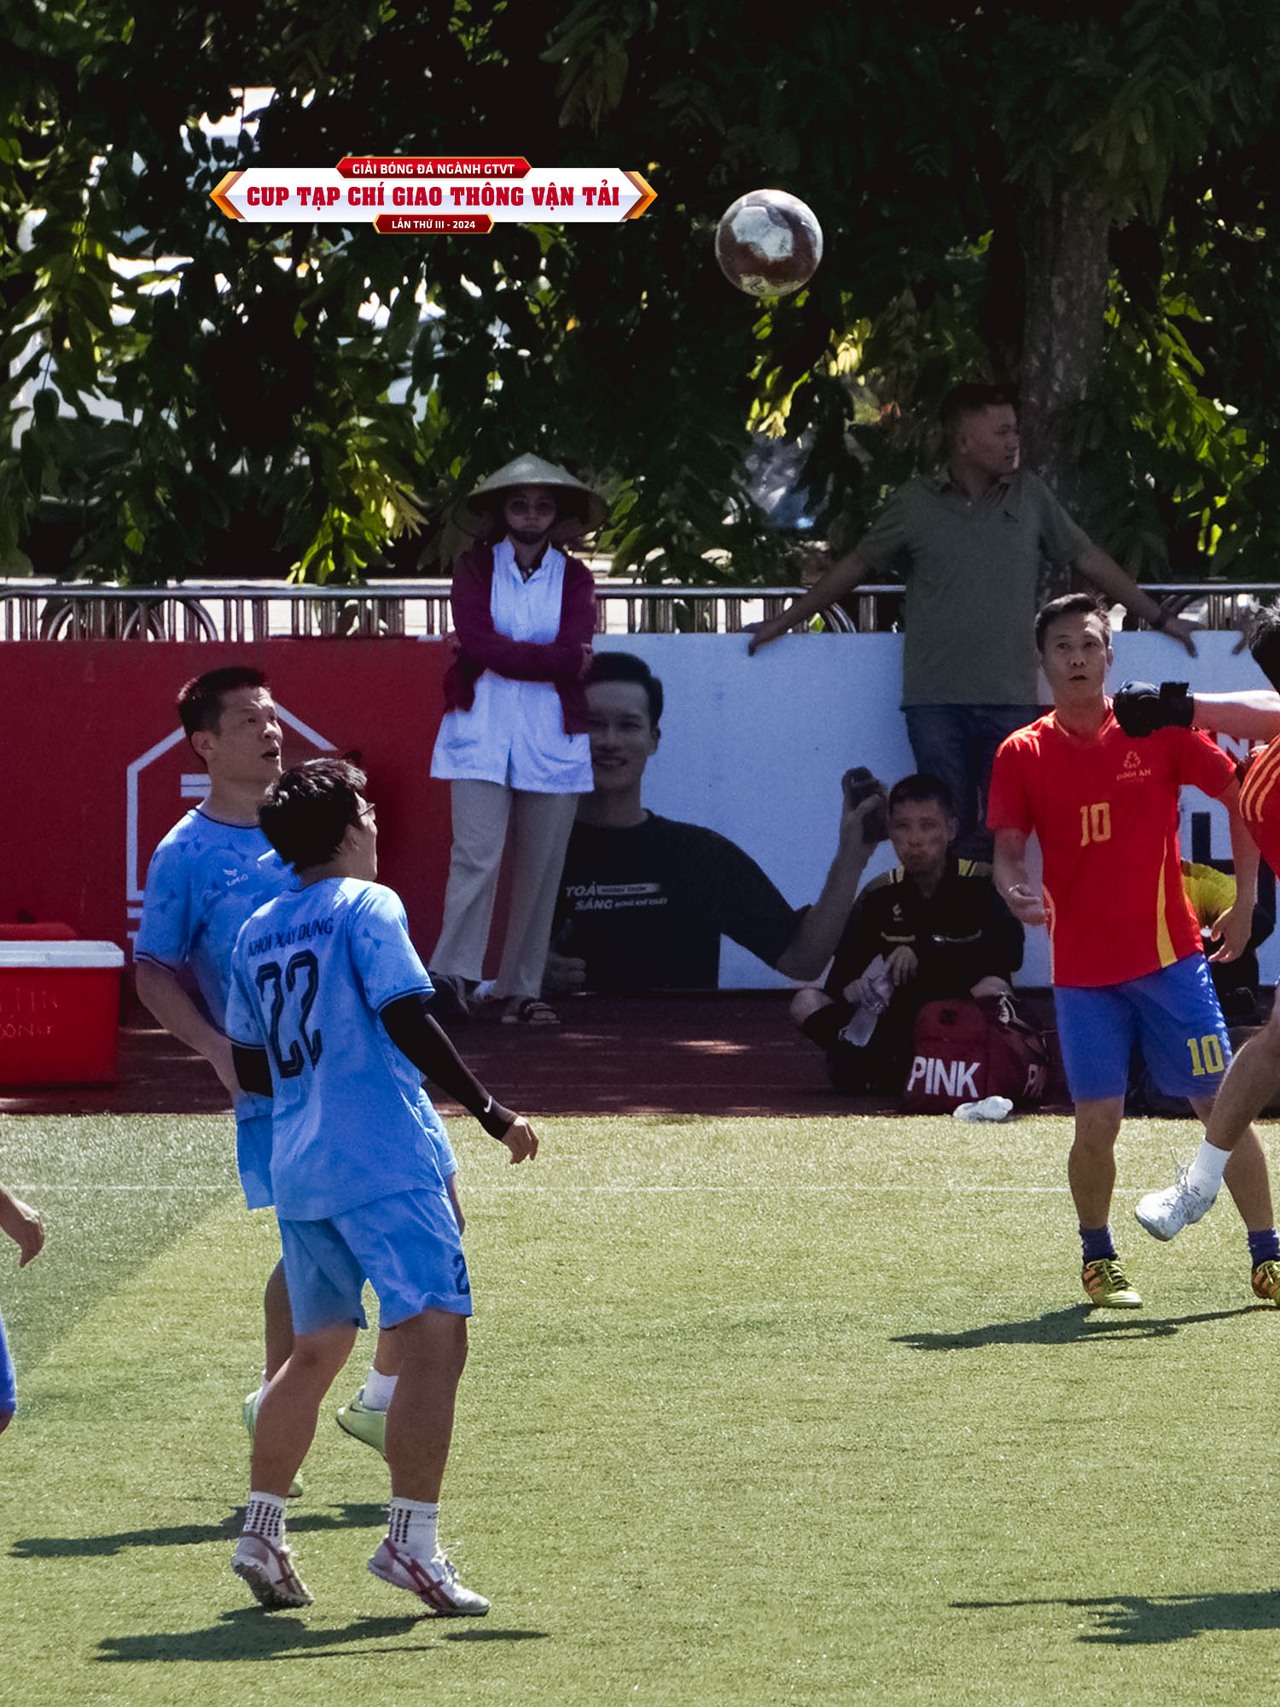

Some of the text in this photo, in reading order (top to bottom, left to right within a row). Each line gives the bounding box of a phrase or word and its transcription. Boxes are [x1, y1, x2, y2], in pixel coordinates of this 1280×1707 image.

[1079, 801, 1112, 847] 10
[255, 949, 324, 1079] 22
[907, 1056, 981, 1098] PINK
[1186, 1034, 1225, 1076] 10
